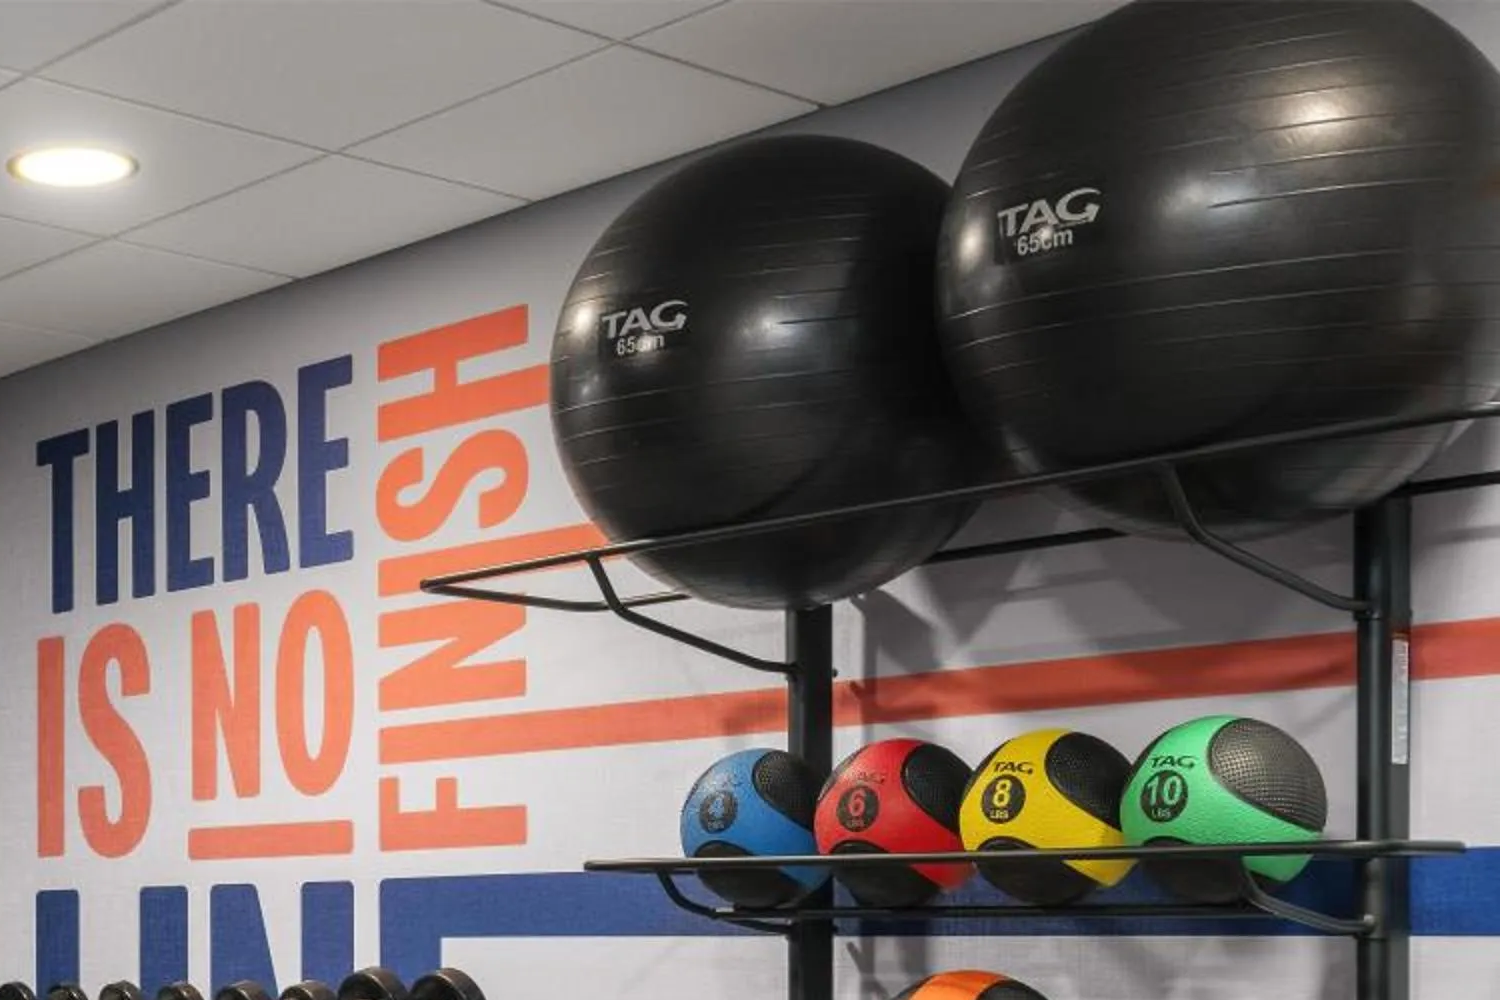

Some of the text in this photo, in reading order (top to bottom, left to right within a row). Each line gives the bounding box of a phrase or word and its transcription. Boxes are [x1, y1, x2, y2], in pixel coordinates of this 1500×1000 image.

[999, 187, 1100, 236] TAG
[1017, 228, 1073, 256] 65cm
[602, 299, 689, 339] TAG
[36, 354, 353, 613] THERE
[376, 303, 529, 852] FINISH
[37, 589, 354, 859] IS NO
[994, 761, 1035, 775] TAG
[1151, 755, 1202, 769] TAG
[847, 771, 886, 786] AG
[992, 778, 1012, 808] 8
[1147, 776, 1182, 807] 10
[848, 789, 865, 817] 6
